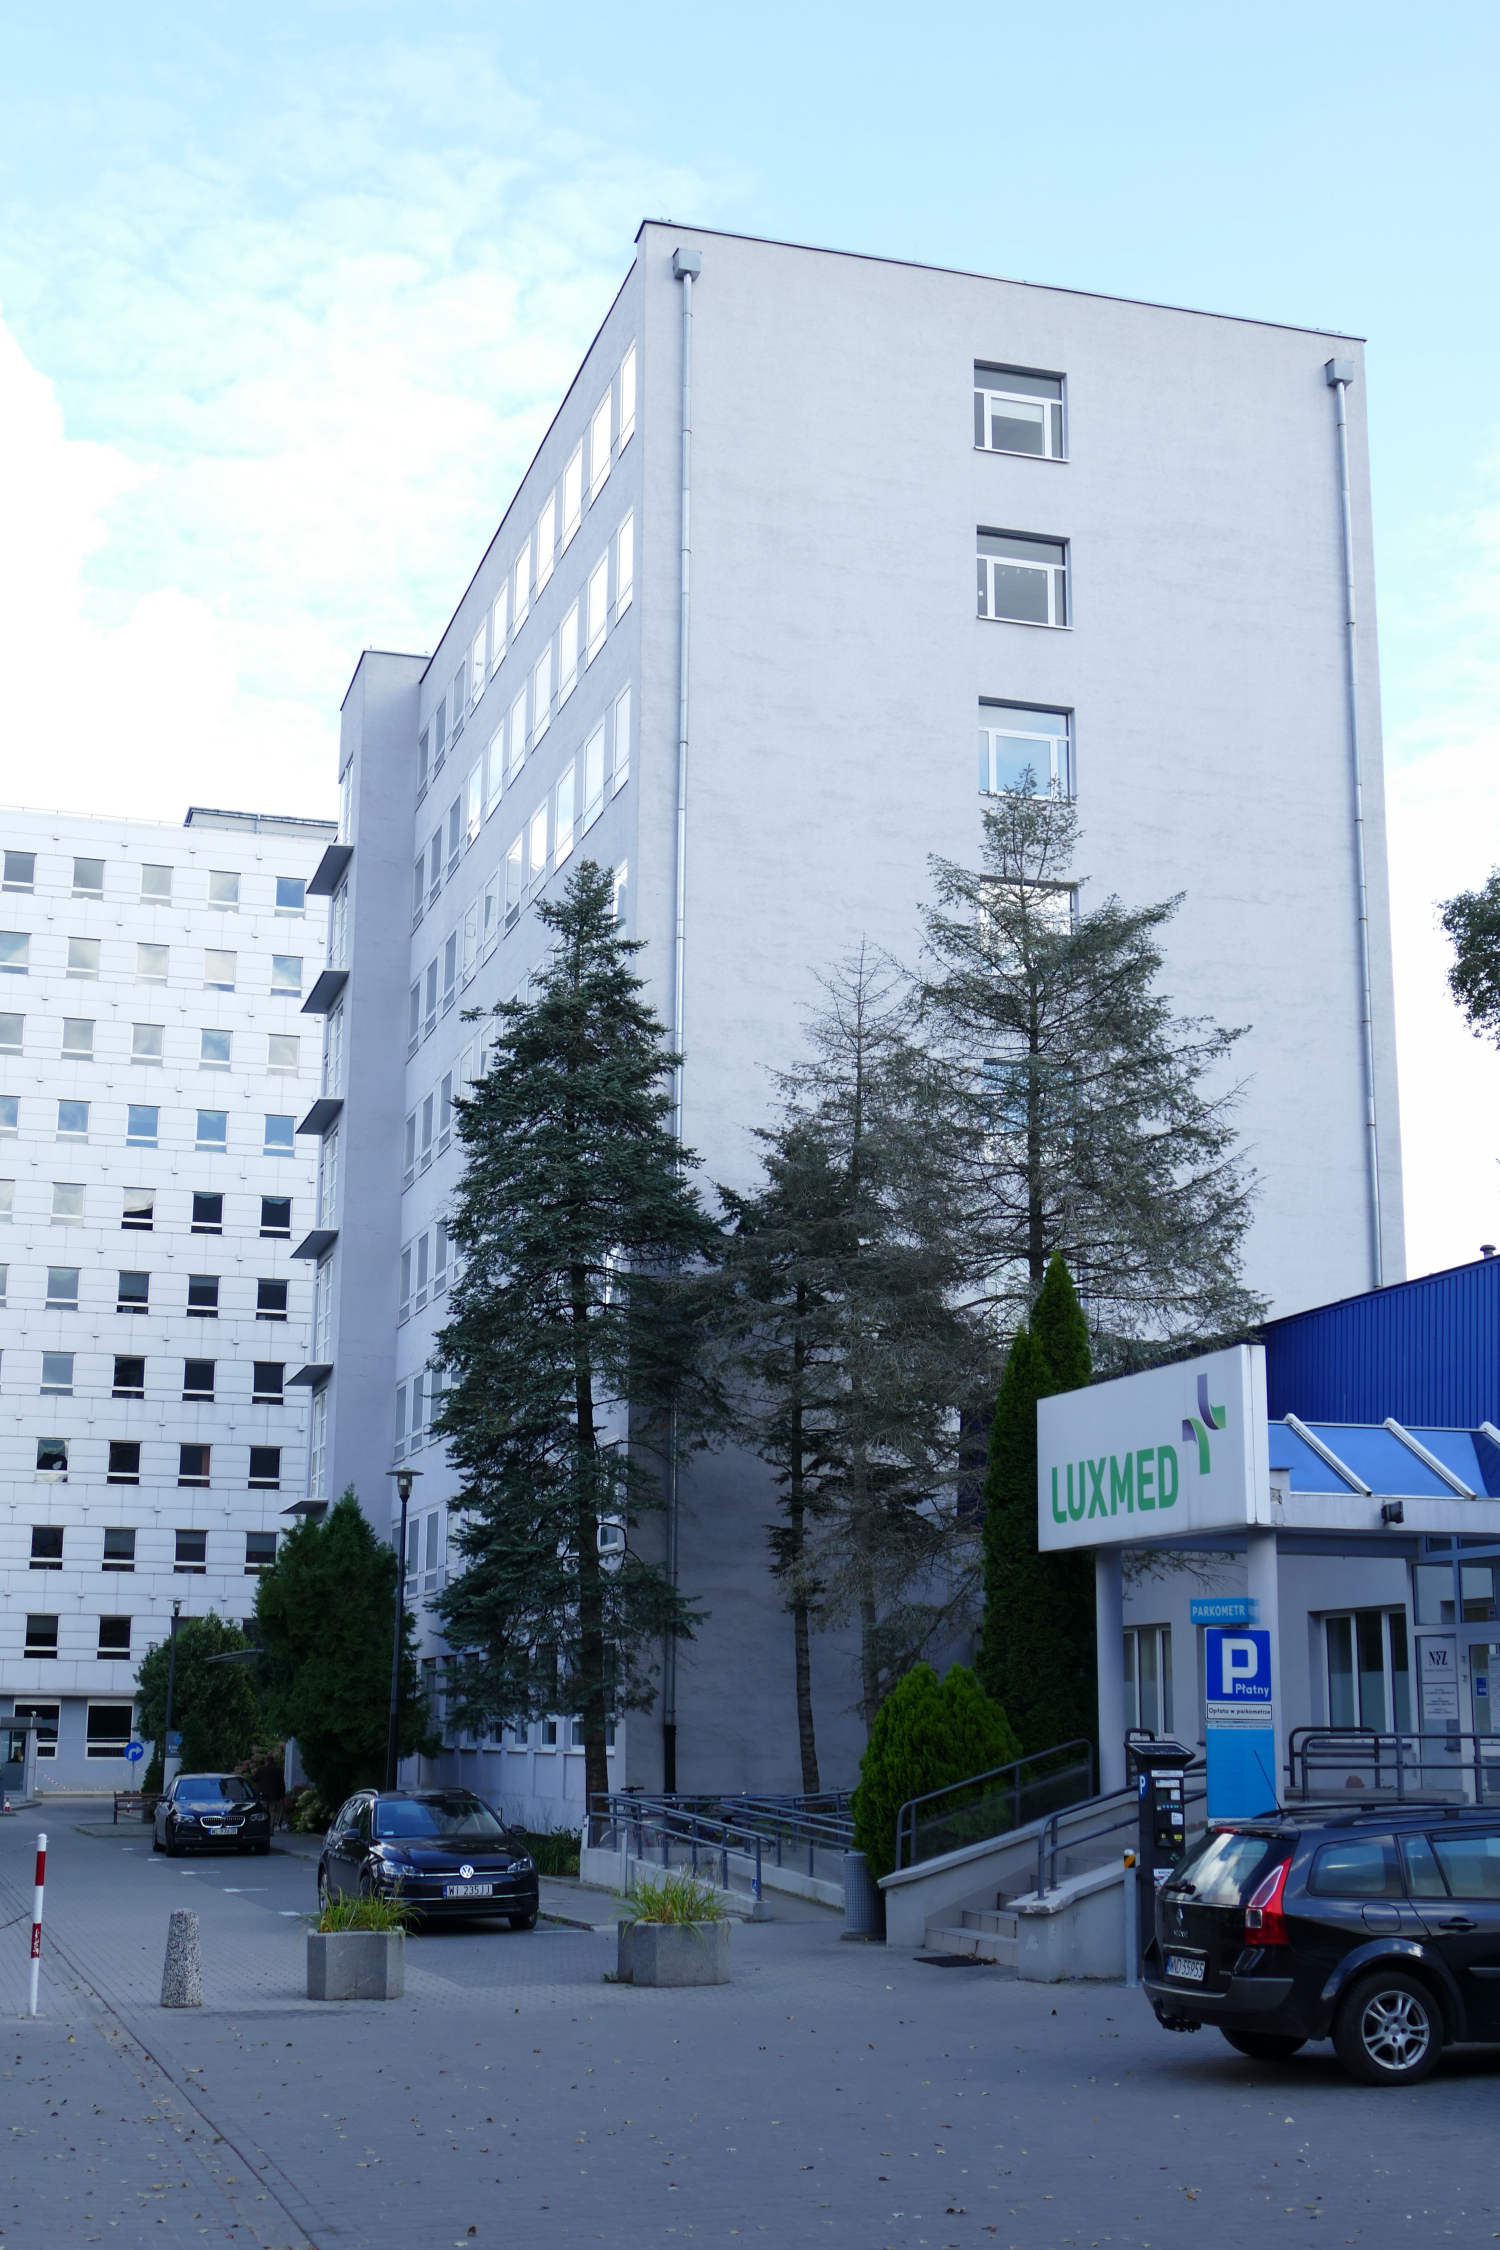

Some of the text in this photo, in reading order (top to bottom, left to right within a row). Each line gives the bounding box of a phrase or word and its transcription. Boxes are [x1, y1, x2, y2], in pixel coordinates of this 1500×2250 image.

[1051, 1445, 1179, 1524] LUXMED
[1192, 1604, 1245, 1617] PARKOMETR
[1221, 1638, 1258, 1694] P
[1429, 1650, 1448, 1666] NFZ
[1235, 1683, 1269, 1698] Płatny
[1208, 1707, 1229, 1715] Opłata
[1139, 1775, 1146, 1795] P
[448, 1885, 490, 1895] WI 235JJ
[1181, 1959, 1205, 1978] 55955
